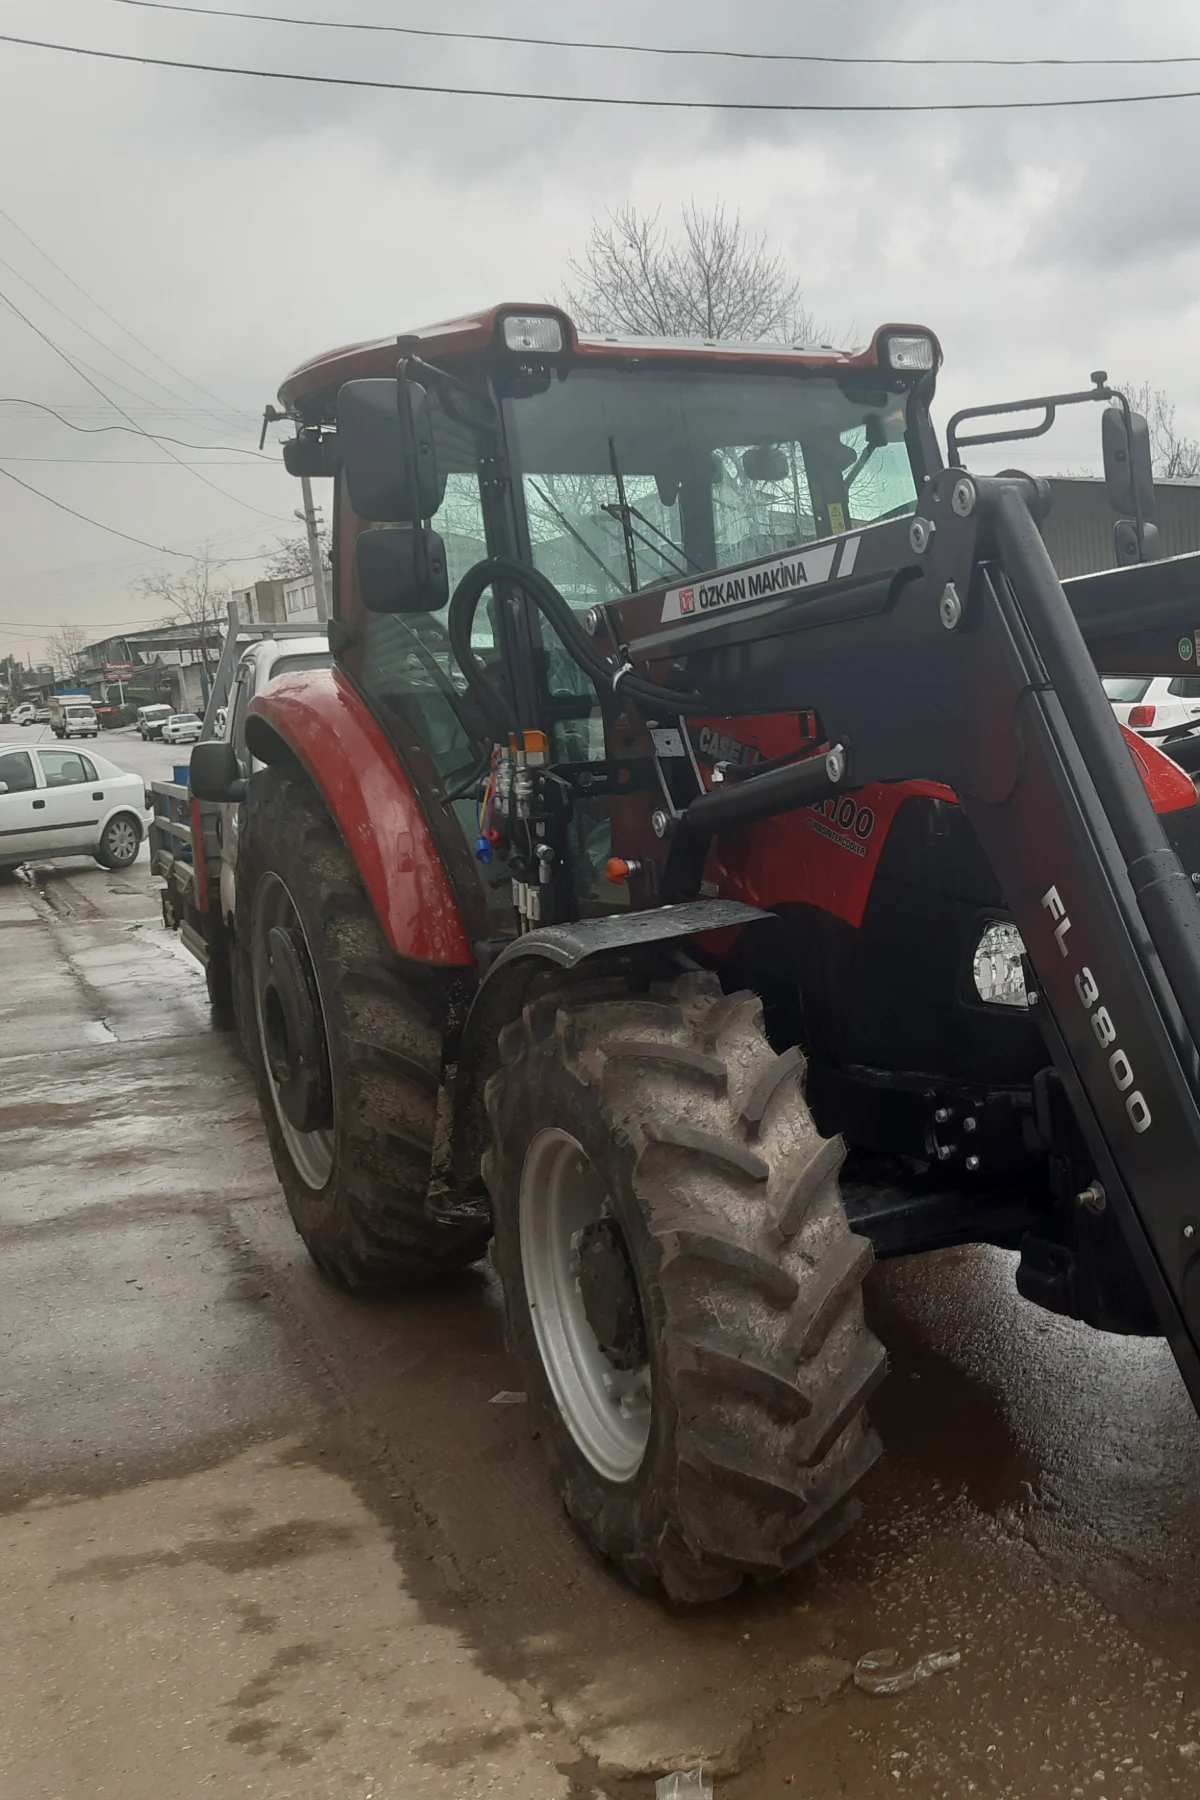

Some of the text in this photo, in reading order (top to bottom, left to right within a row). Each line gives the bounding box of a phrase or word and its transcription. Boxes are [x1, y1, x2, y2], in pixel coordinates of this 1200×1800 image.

[699, 577, 746, 609] ÖZKAN
[748, 561, 808, 598] MAKİNA
[699, 726, 742, 765] CASE
[1041, 884, 1152, 1134] FL 3800
